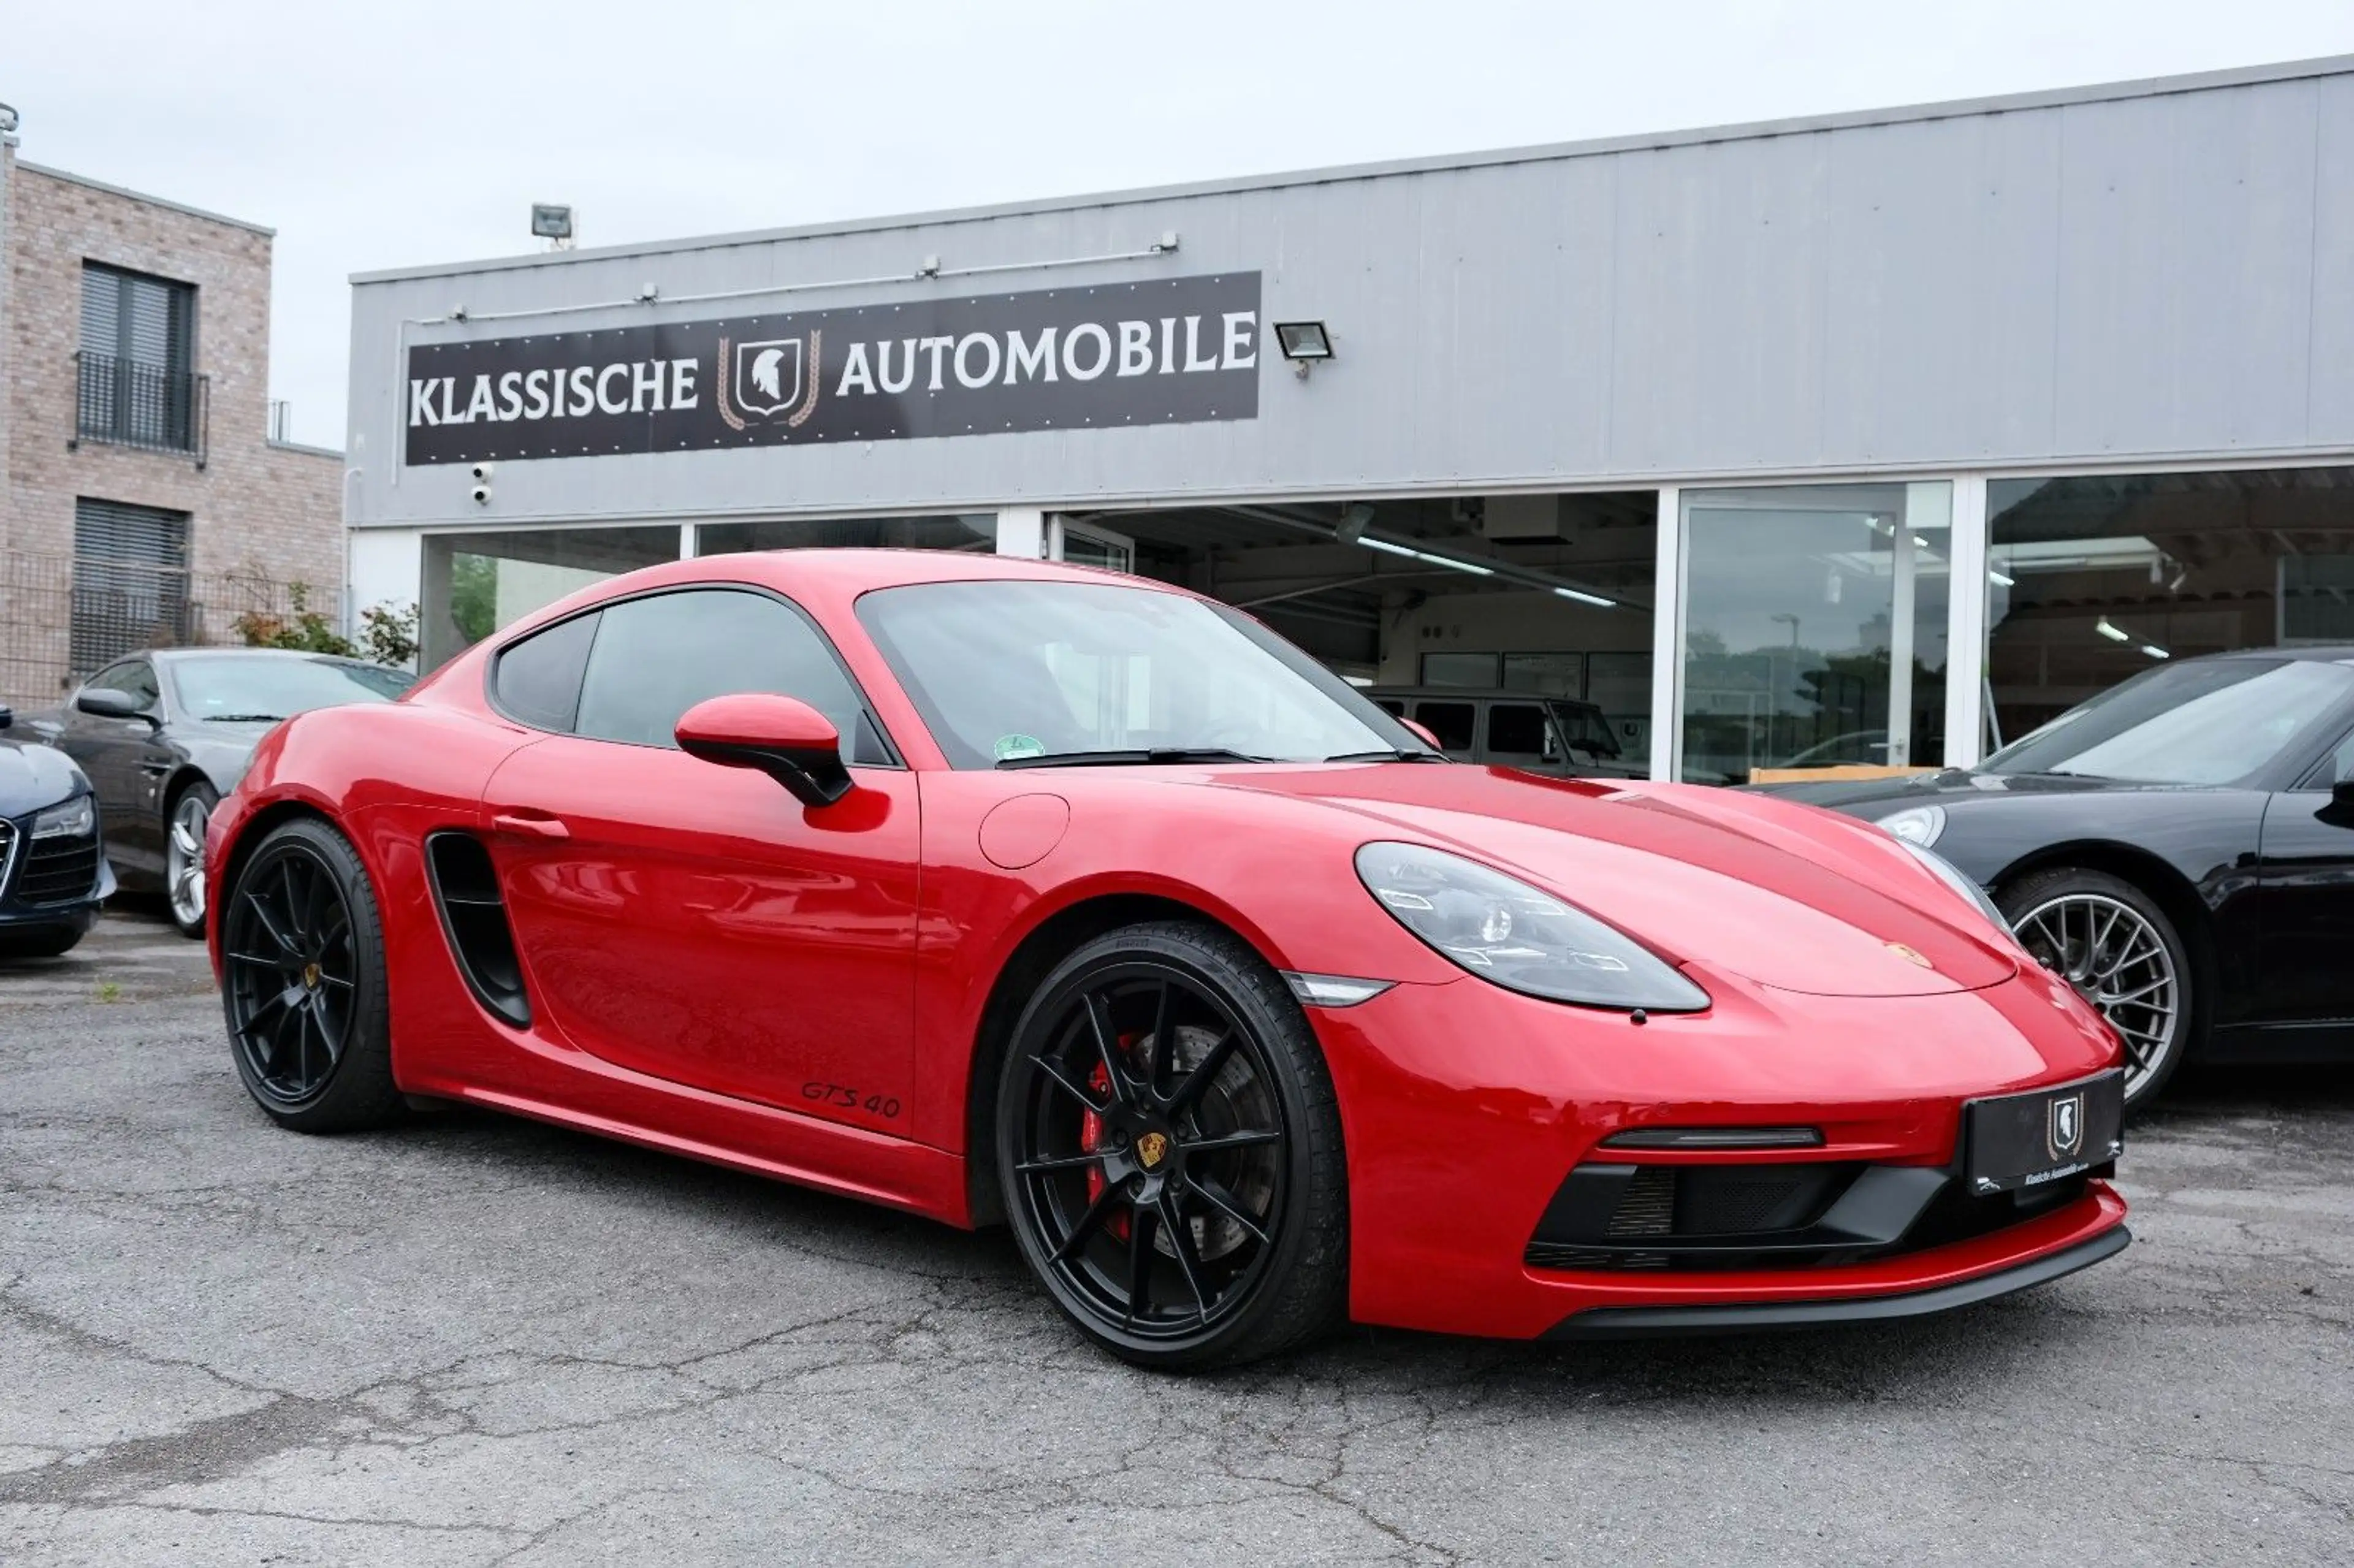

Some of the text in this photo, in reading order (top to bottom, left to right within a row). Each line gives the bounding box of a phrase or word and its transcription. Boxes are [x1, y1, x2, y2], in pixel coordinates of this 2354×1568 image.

[409, 311, 1257, 426] KLASSISCHE AUTOMOBILE
[802, 1082, 858, 1107] GTS
